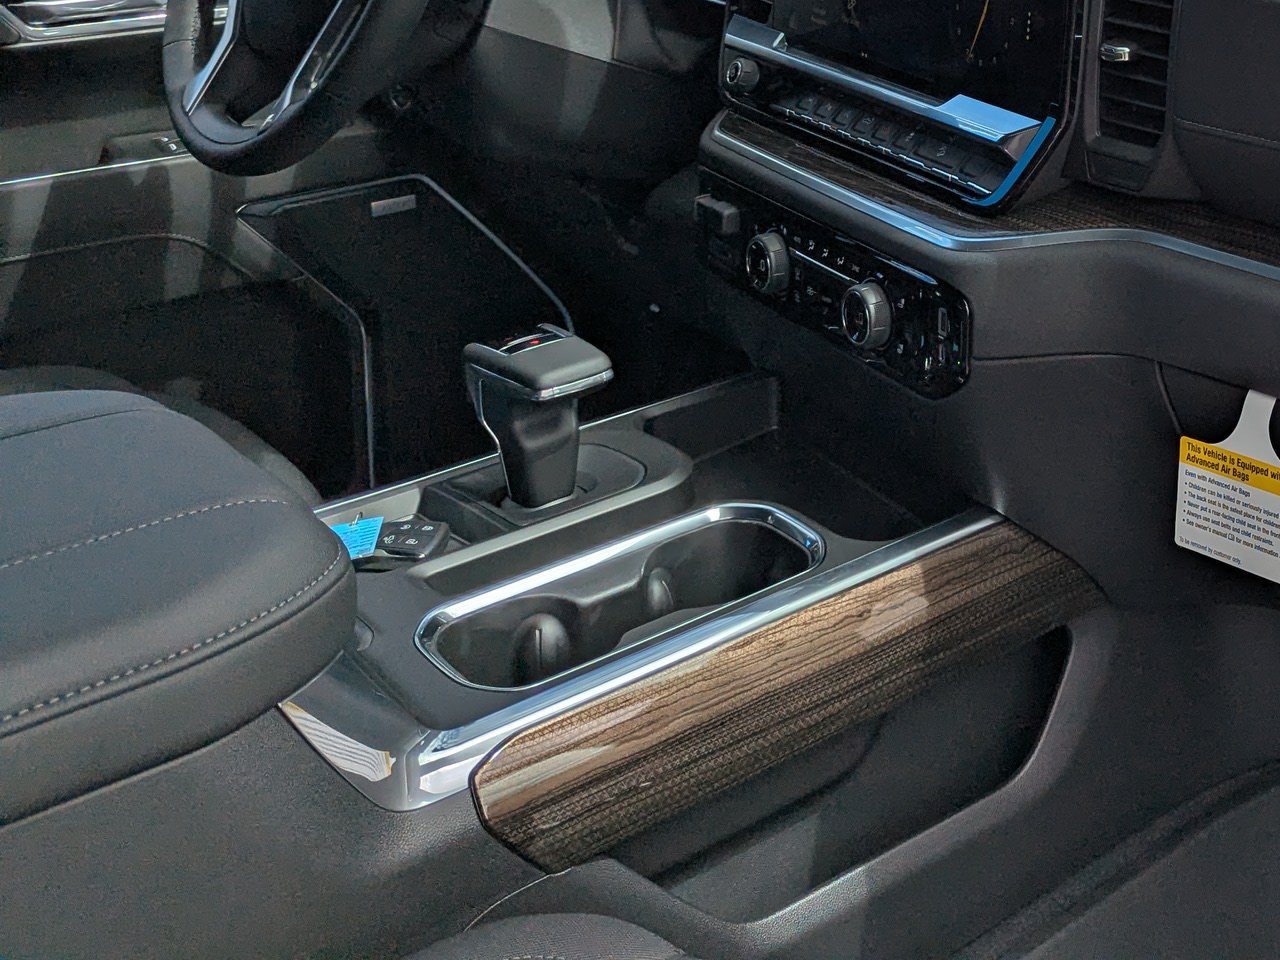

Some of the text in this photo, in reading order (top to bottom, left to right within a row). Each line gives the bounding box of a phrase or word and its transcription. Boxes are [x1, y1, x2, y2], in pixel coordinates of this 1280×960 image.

[1186, 453, 1249, 481] Advanced Air Bags
[1187, 442, 1201, 454] This
[1203, 447, 1227, 462] Vehicle
[1229, 455, 1235, 465] is
[1237, 458, 1269, 476] Equipped
[1185, 469, 1196, 478] Even
[1208, 478, 1230, 489] Advanced
[1189, 482, 1206, 492] Children
[1223, 494, 1235, 503] killed
[1242, 501, 1262, 513] seriously
[1263, 508, 1279, 518] injured
